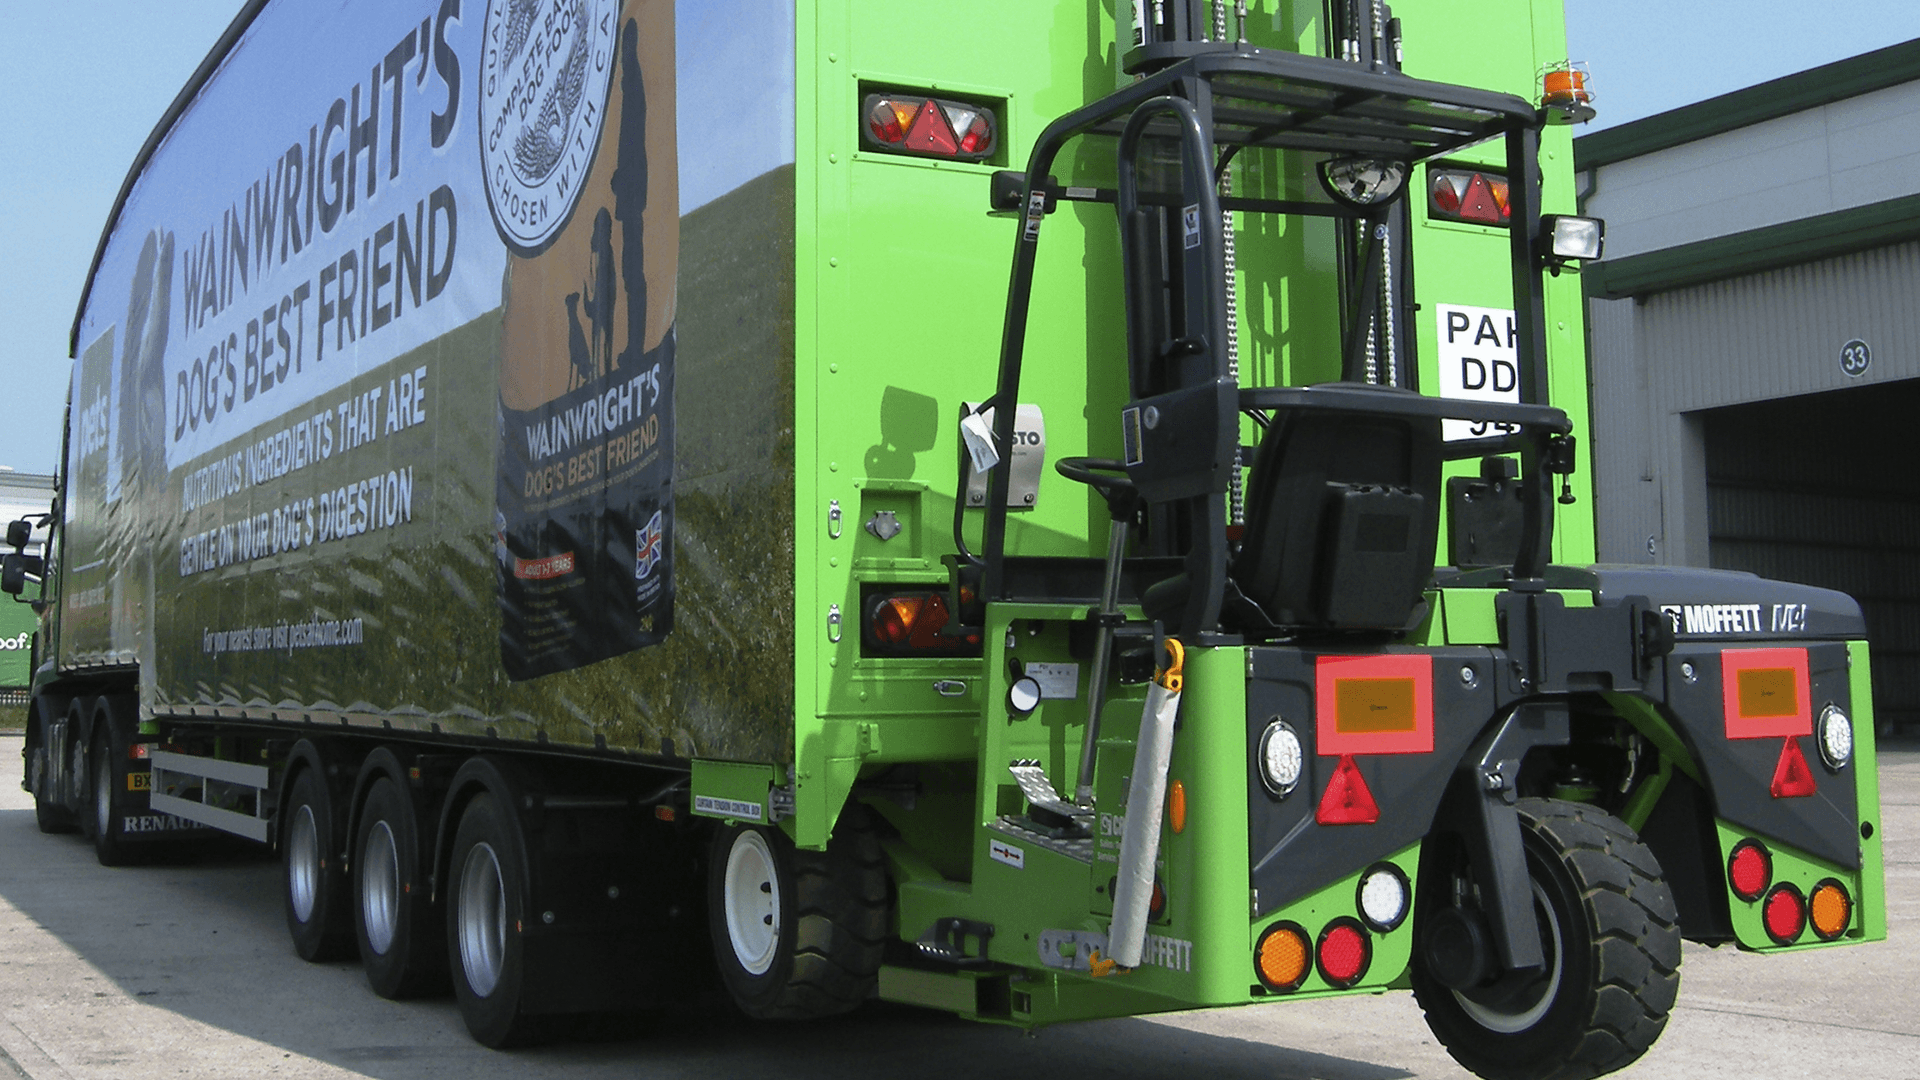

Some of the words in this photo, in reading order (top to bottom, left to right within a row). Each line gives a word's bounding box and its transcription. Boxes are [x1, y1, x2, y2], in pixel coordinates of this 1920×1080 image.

[489, 32, 543, 152] COMPLETE
[519, 65, 544, 121] DOG
[546, 0, 580, 68] FOOD
[183, 0, 461, 341] WAINWRIGHT'S
[496, 164, 548, 226] CHOSEN
[557, 101, 596, 199] WITH
[175, 332, 237, 442] DOG'S
[244, 279, 310, 403] BEST
[317, 184, 458, 361] FRIEND
[1845, 346, 1866, 370] 33
[526, 362, 660, 461] WAINWRIGHT'S
[1462, 357, 1516, 392] DD
[182, 450, 242, 513] NUTRITIOUS
[245, 409, 333, 488] INGREDIENTS
[338, 386, 382, 452] THAT
[385, 365, 427, 436] ARE
[524, 462, 564, 498] DOG'S
[568, 445, 602, 486] BEST
[607, 413, 659, 470] FRIEND
[180, 528, 216, 577] GENTLE
[218, 524, 234, 567] ON
[238, 512, 269, 562] YOUR
[273, 497, 314, 554] DOG'S
[319, 465, 413, 543] DIGESTION
[1684, 604, 1761, 633] MOFFETT
[124, 815, 208, 832] RENAUL
[1142, 932, 1193, 972] OFFETT
